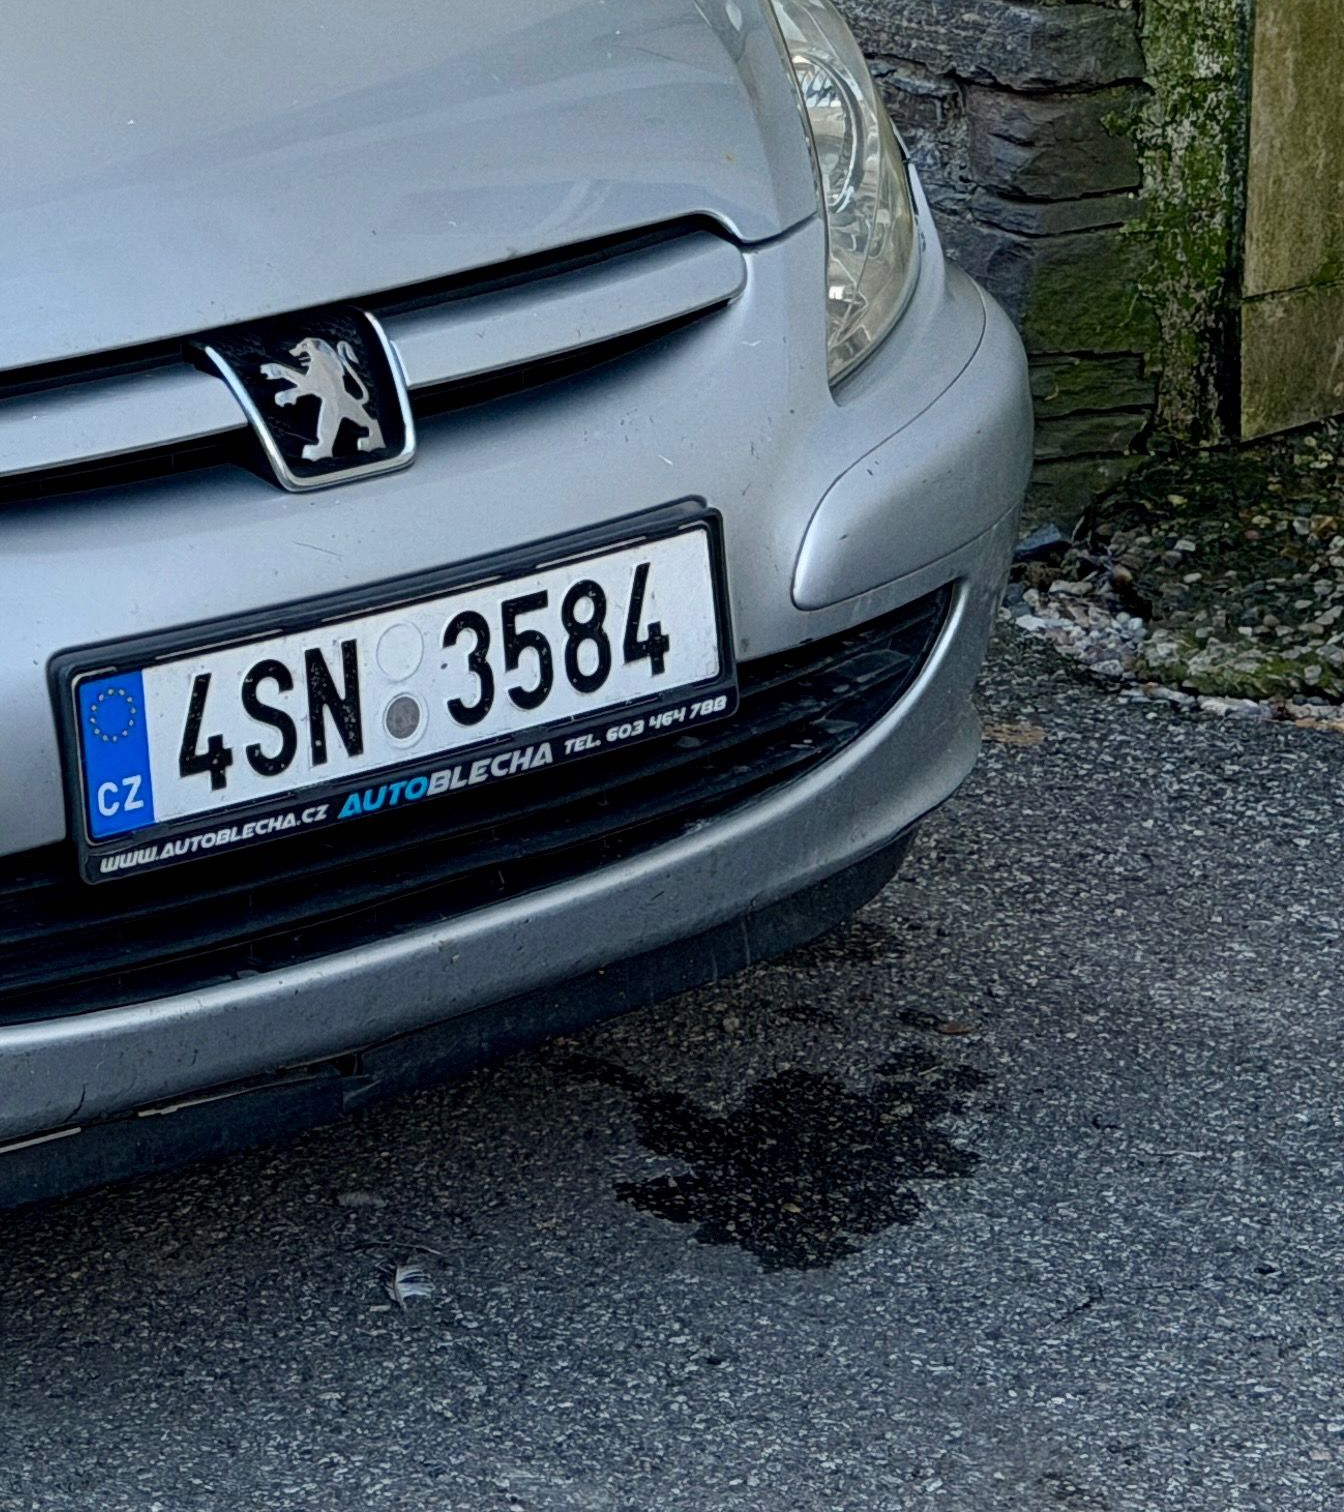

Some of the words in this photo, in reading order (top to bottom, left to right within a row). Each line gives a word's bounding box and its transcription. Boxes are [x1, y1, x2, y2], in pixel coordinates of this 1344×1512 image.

[178, 639, 365, 792] 4SN
[442, 561, 670, 727] 3584
[98, 775, 145, 817] CZ
[338, 741, 554, 819] AUTOBLECHA
[564, 733, 602, 755] TEL.
[606, 720, 645, 743] 603
[650, 707, 686, 730] 464
[690, 695, 727, 720] 788
